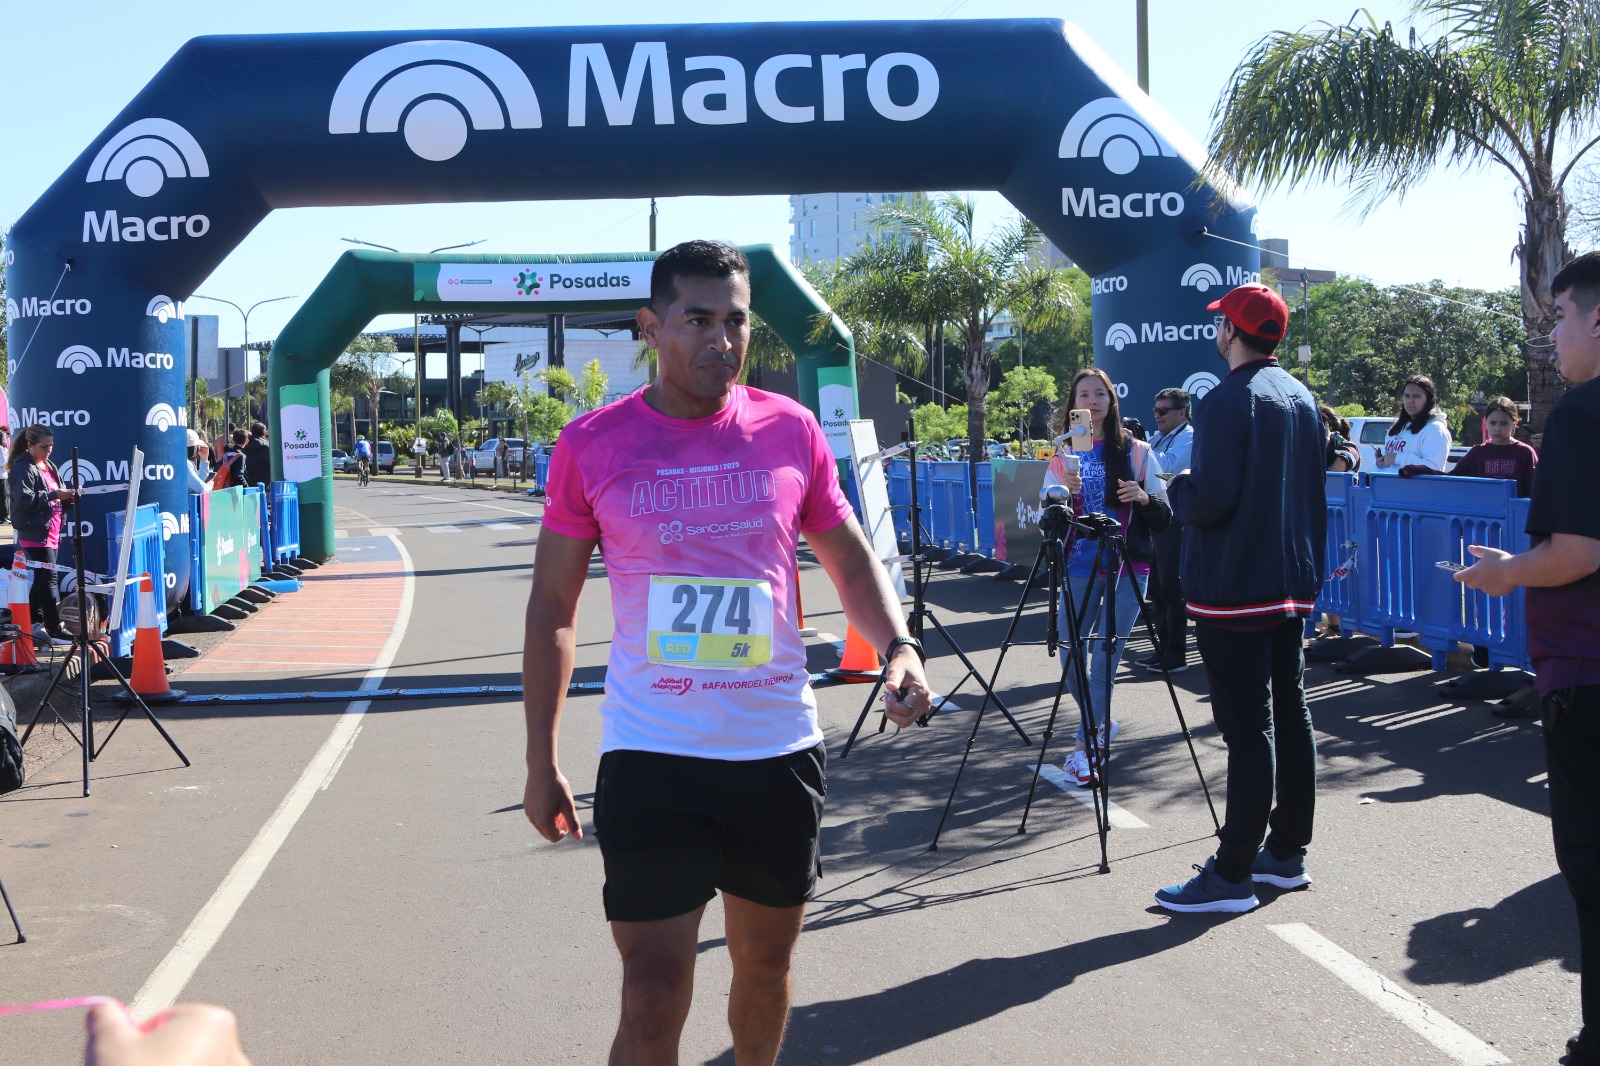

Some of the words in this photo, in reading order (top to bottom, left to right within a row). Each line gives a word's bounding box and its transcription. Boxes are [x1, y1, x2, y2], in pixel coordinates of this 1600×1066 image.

[567, 41, 940, 127] Macro
[1061, 187, 1185, 219] Macro
[82, 209, 210, 243] Macro
[549, 271, 631, 289] Posadas
[22, 296, 92, 318] Macro
[1141, 321, 1218, 343] Macro
[107, 347, 174, 369] Macro
[21, 406, 91, 427] Macro
[283, 441, 319, 450] Posadas
[105, 459, 175, 481] Mcro
[656, 467, 685, 476] POSADAS
[688, 464, 719, 474] MISIONES
[722, 460, 740, 470] 2025
[630, 470, 777, 517] ACTITUD
[685, 518, 764, 536] SanCorSalud
[671, 584, 751, 635] 274
[665, 643, 691, 654] RED
[731, 642, 751, 658] 5k
